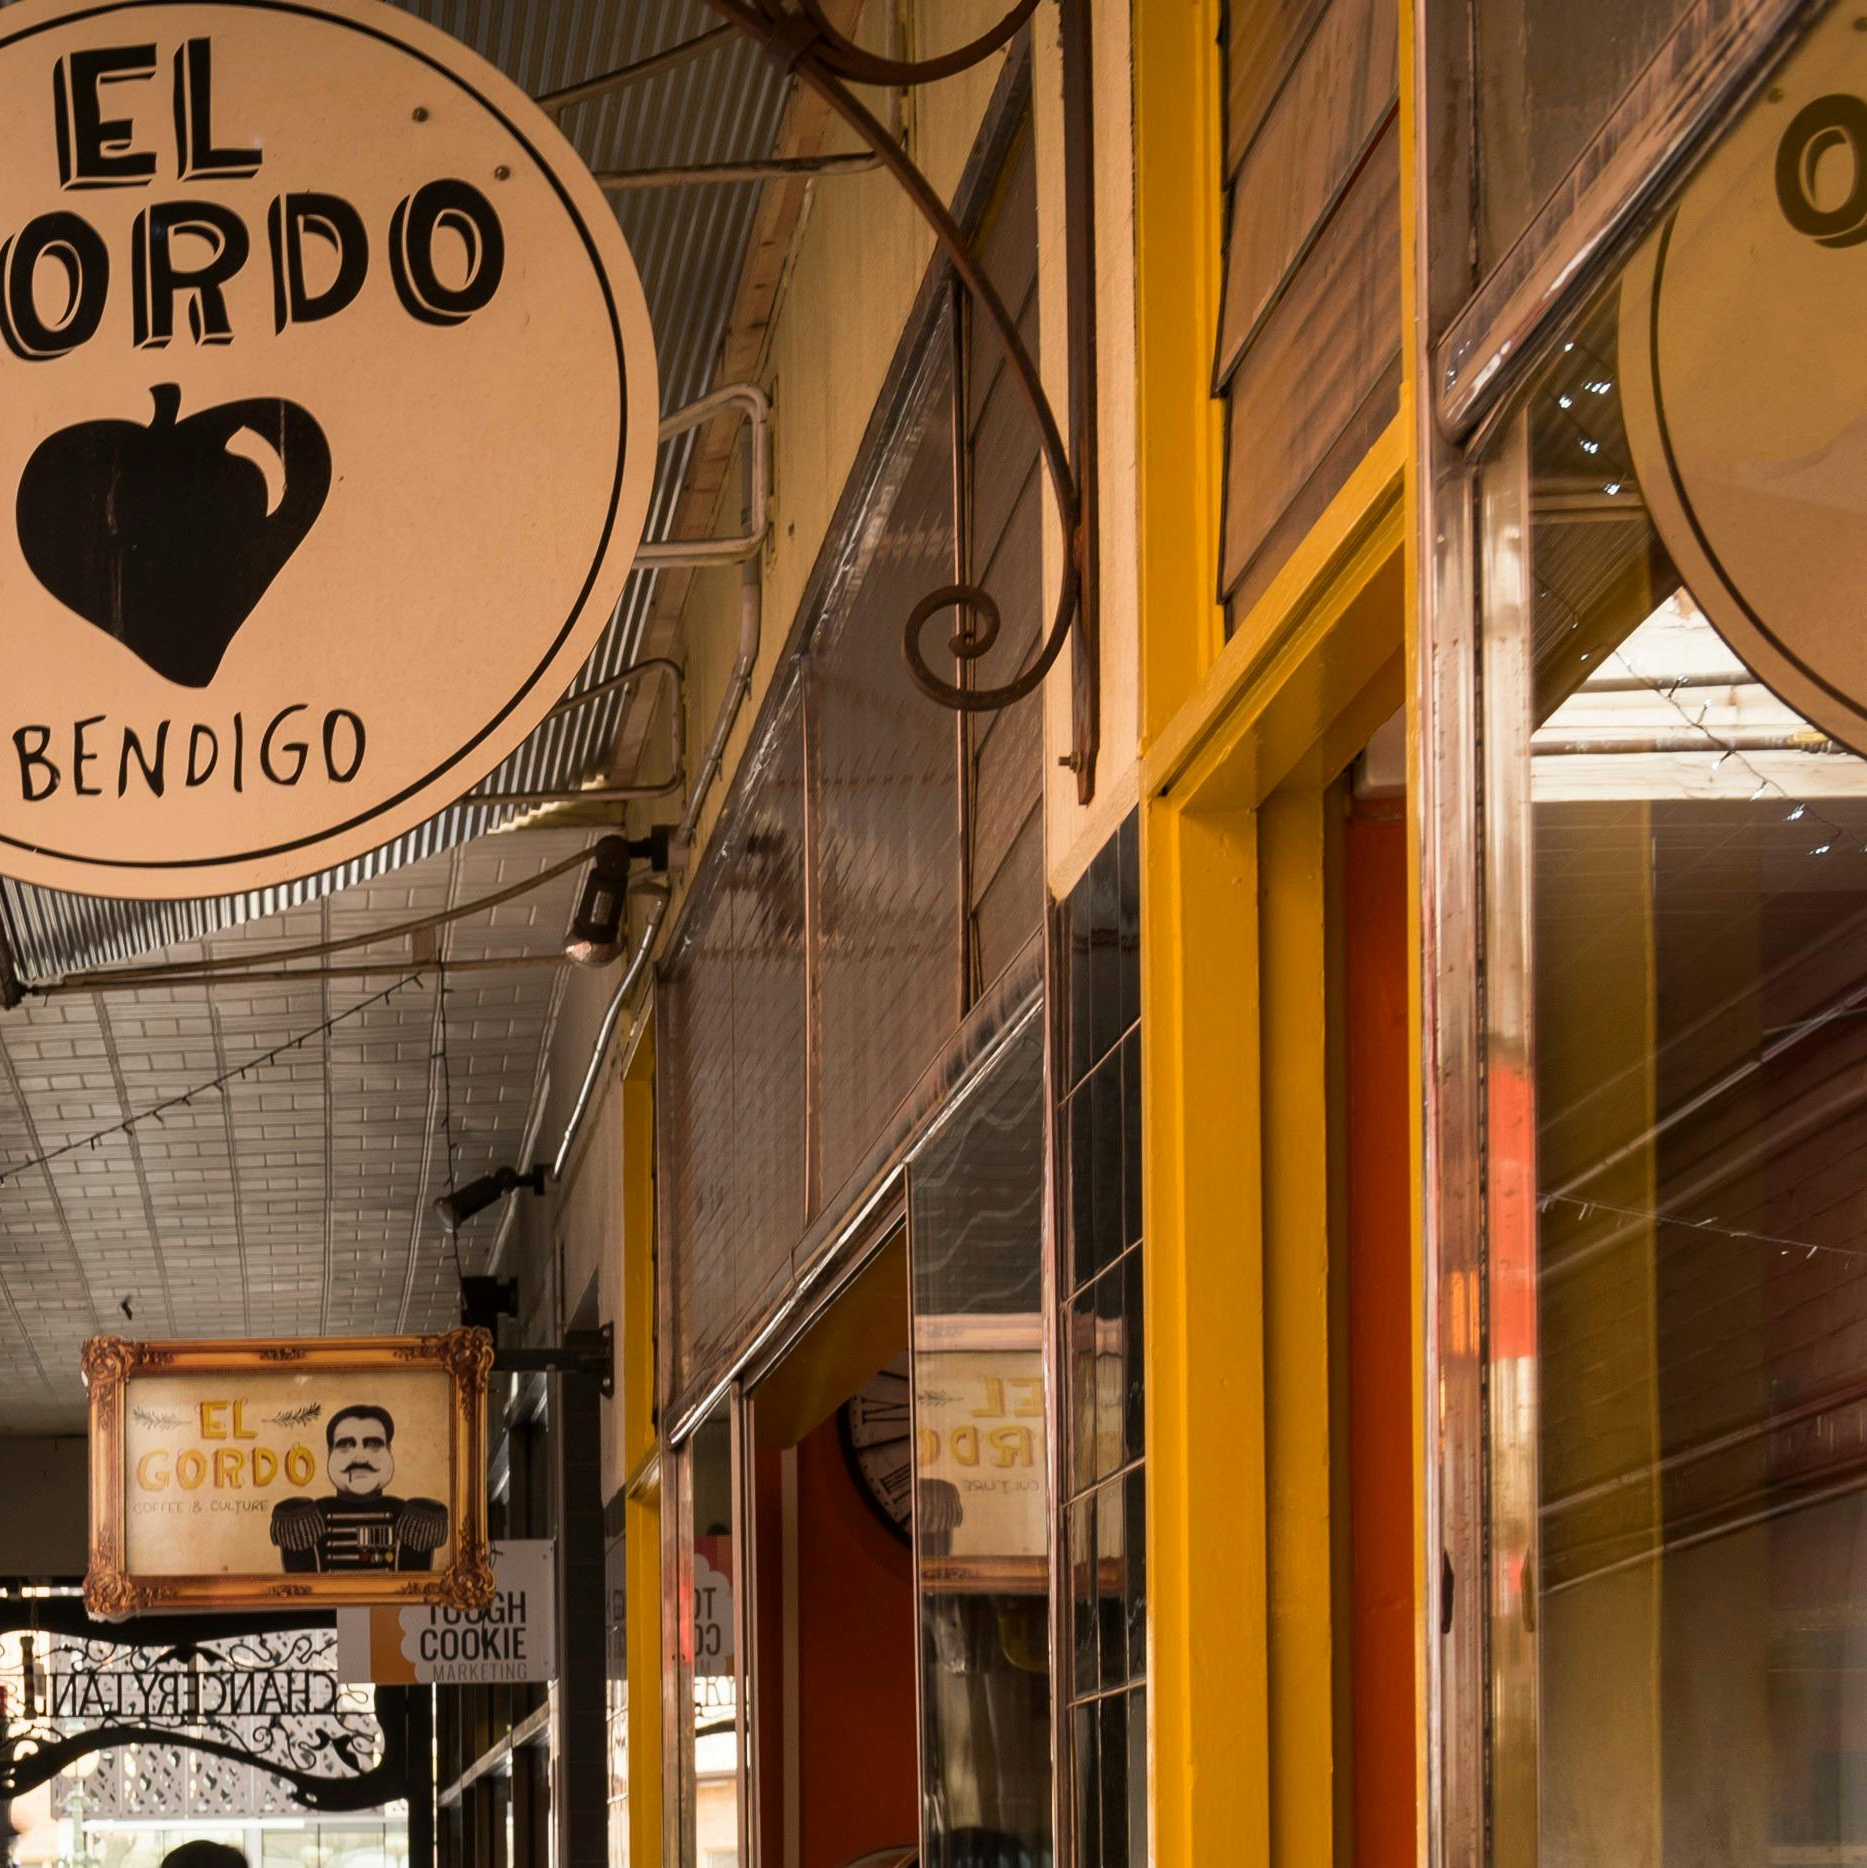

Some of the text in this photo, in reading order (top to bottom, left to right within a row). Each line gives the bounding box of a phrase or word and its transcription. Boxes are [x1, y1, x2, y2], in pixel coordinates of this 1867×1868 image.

[54, 37, 263, 191] EL
[13, 703, 366, 803] BENDIGO
[200, 1399, 258, 1441] EL
[137, 1445, 316, 1492] GORDO
[133, 1499, 267, 1515] COFFEE & CULTURE
[420, 1627, 527, 1661] COOKIE
[433, 1663, 527, 1681] MARKETING
